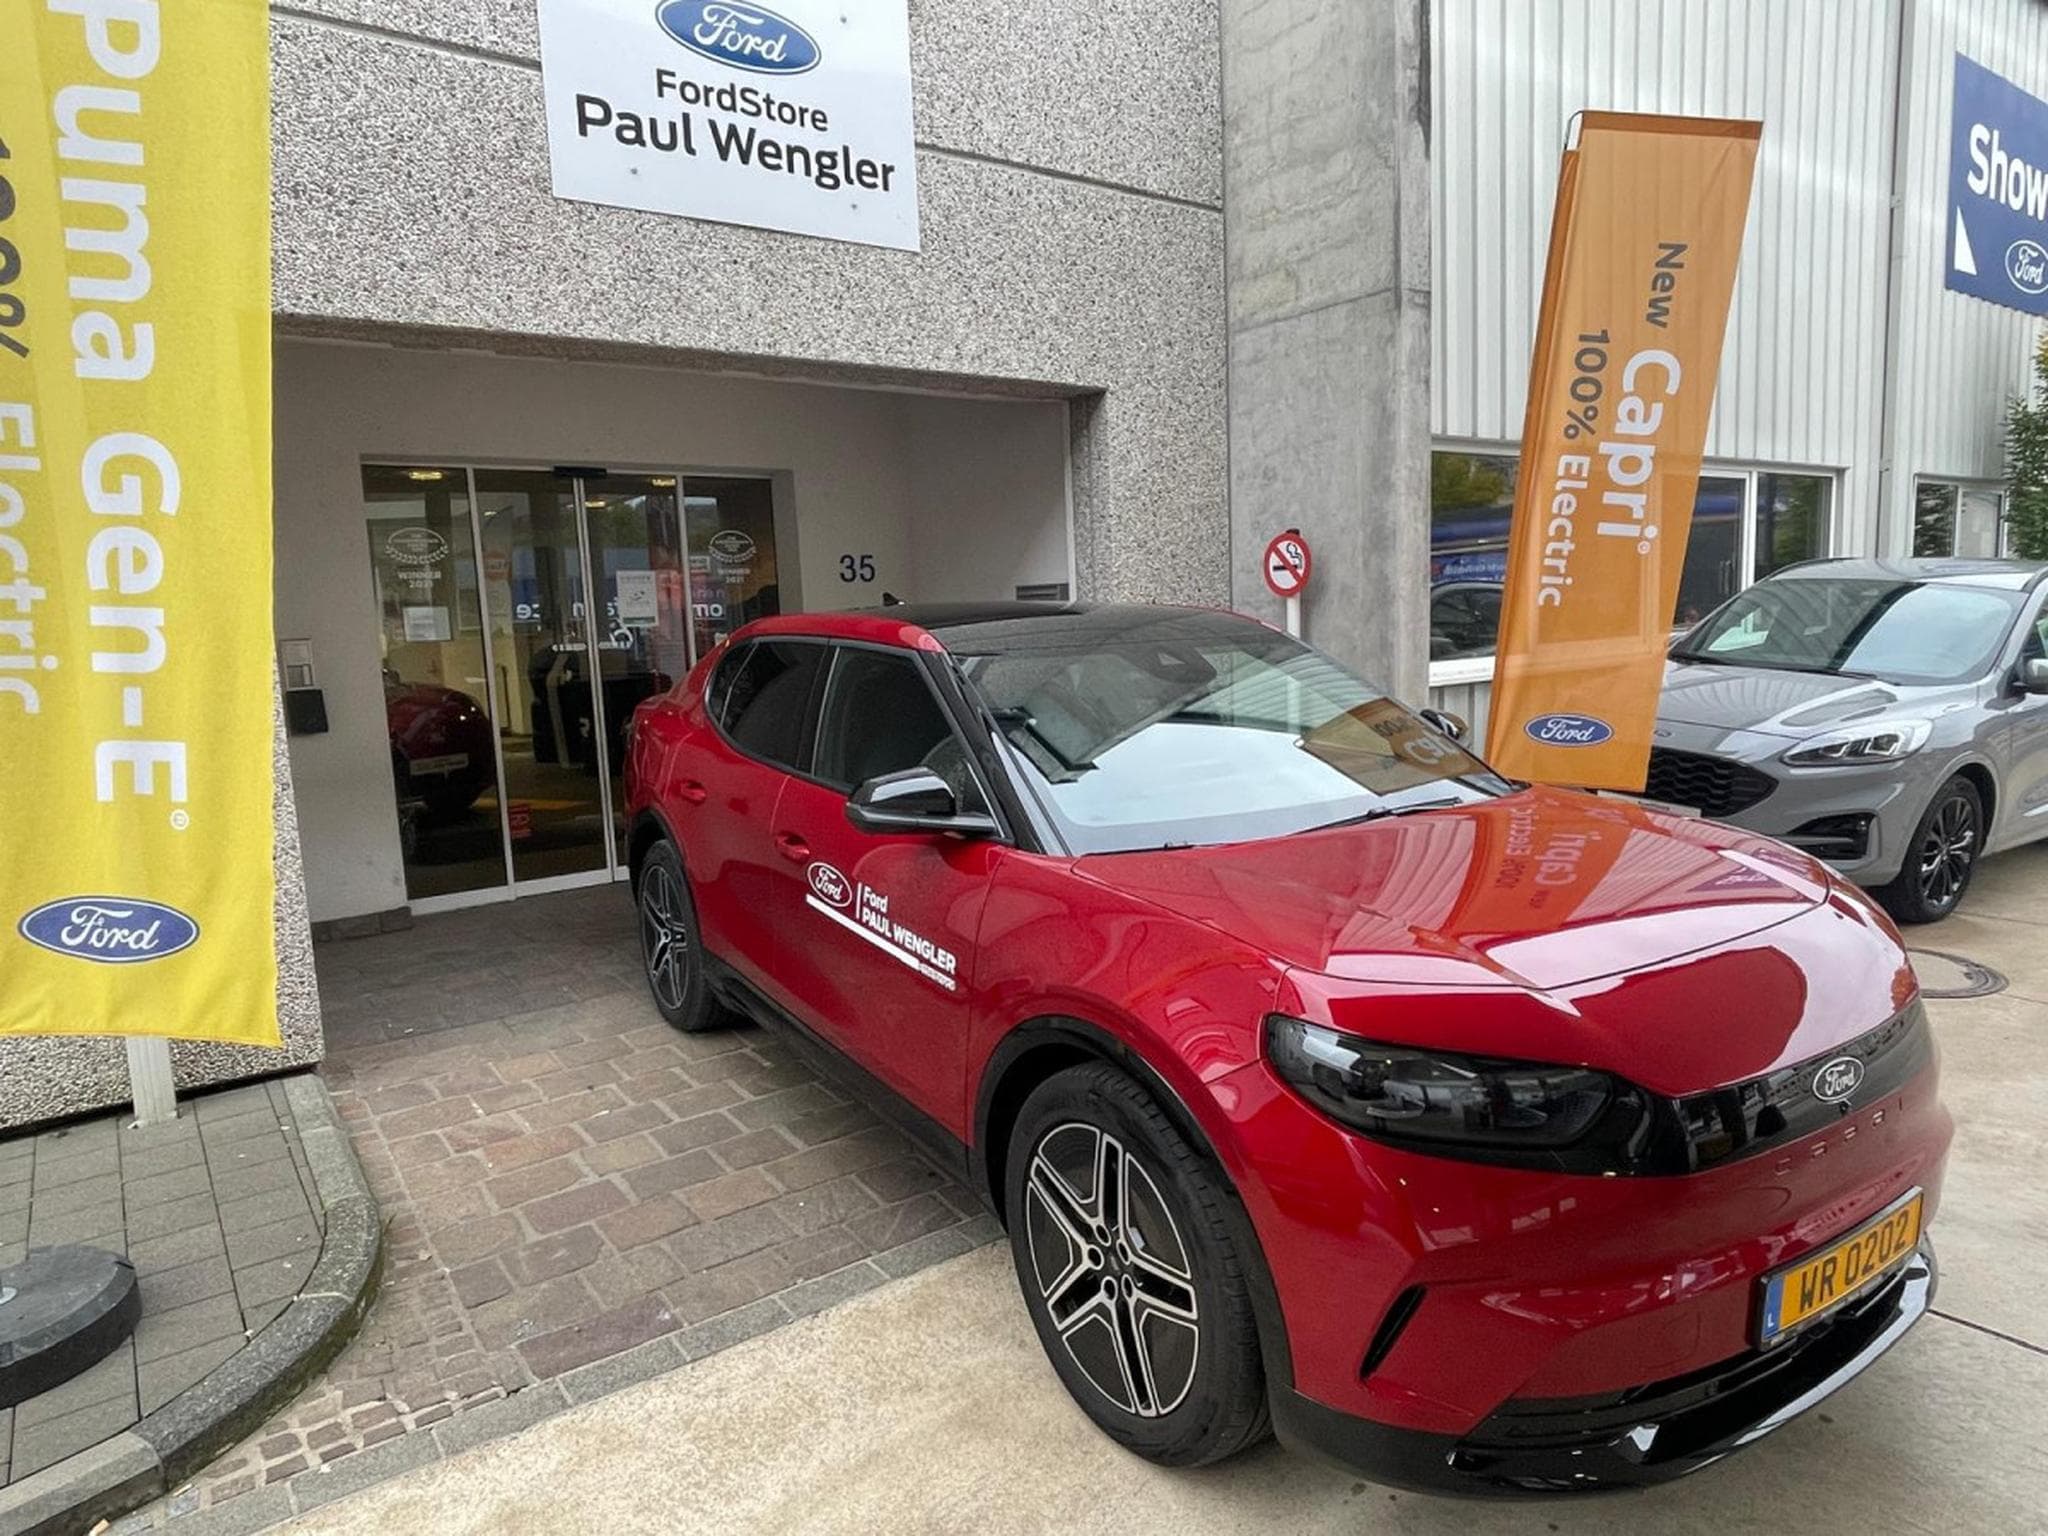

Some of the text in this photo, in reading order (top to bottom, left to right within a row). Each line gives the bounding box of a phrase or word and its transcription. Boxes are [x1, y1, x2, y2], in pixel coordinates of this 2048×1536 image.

[694, 4, 786, 63] Ford
[656, 68, 828, 131] FordStore
[576, 93, 895, 191] Paul Wengler
[45, 0, 161, 381] Puma
[2015, 245, 2046, 285] Ford
[1597, 242, 1688, 538] New Capri
[1538, 329, 1610, 607] 100% Electric
[840, 554, 875, 582] 35
[1541, 718, 1595, 742] Ford
[816, 867, 843, 900] Ford
[863, 886, 888, 914] Ford
[60, 905, 158, 951] Ford
[862, 906, 956, 975] PAUL WENGLER
[1825, 1063, 1855, 1096] Ford
[1800, 1210, 1909, 1314] WR 0202
